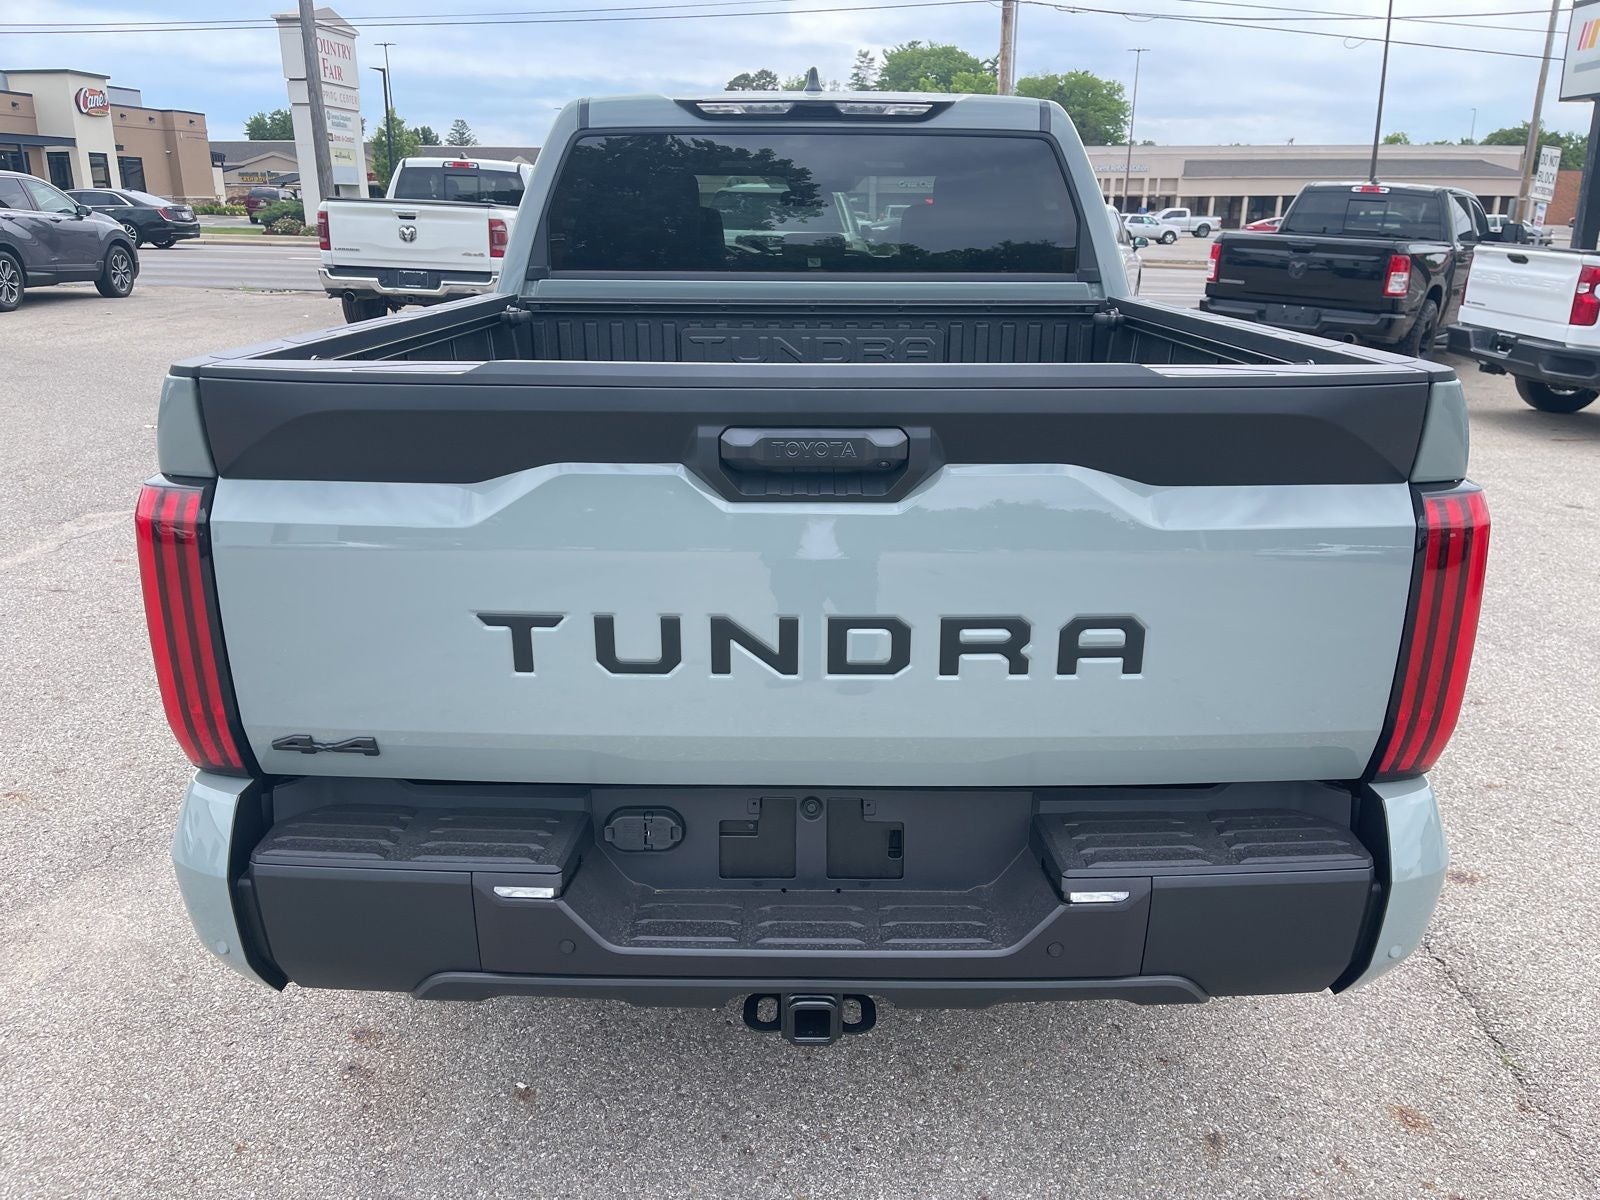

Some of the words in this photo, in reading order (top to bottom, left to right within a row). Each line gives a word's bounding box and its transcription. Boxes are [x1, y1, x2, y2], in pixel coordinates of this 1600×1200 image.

[316, 37, 352, 61] OUNTRY
[688, 336, 937, 362] TUNDRA
[772, 441, 857, 458] TOYOTA
[474, 612, 1147, 677] TUNDRA
